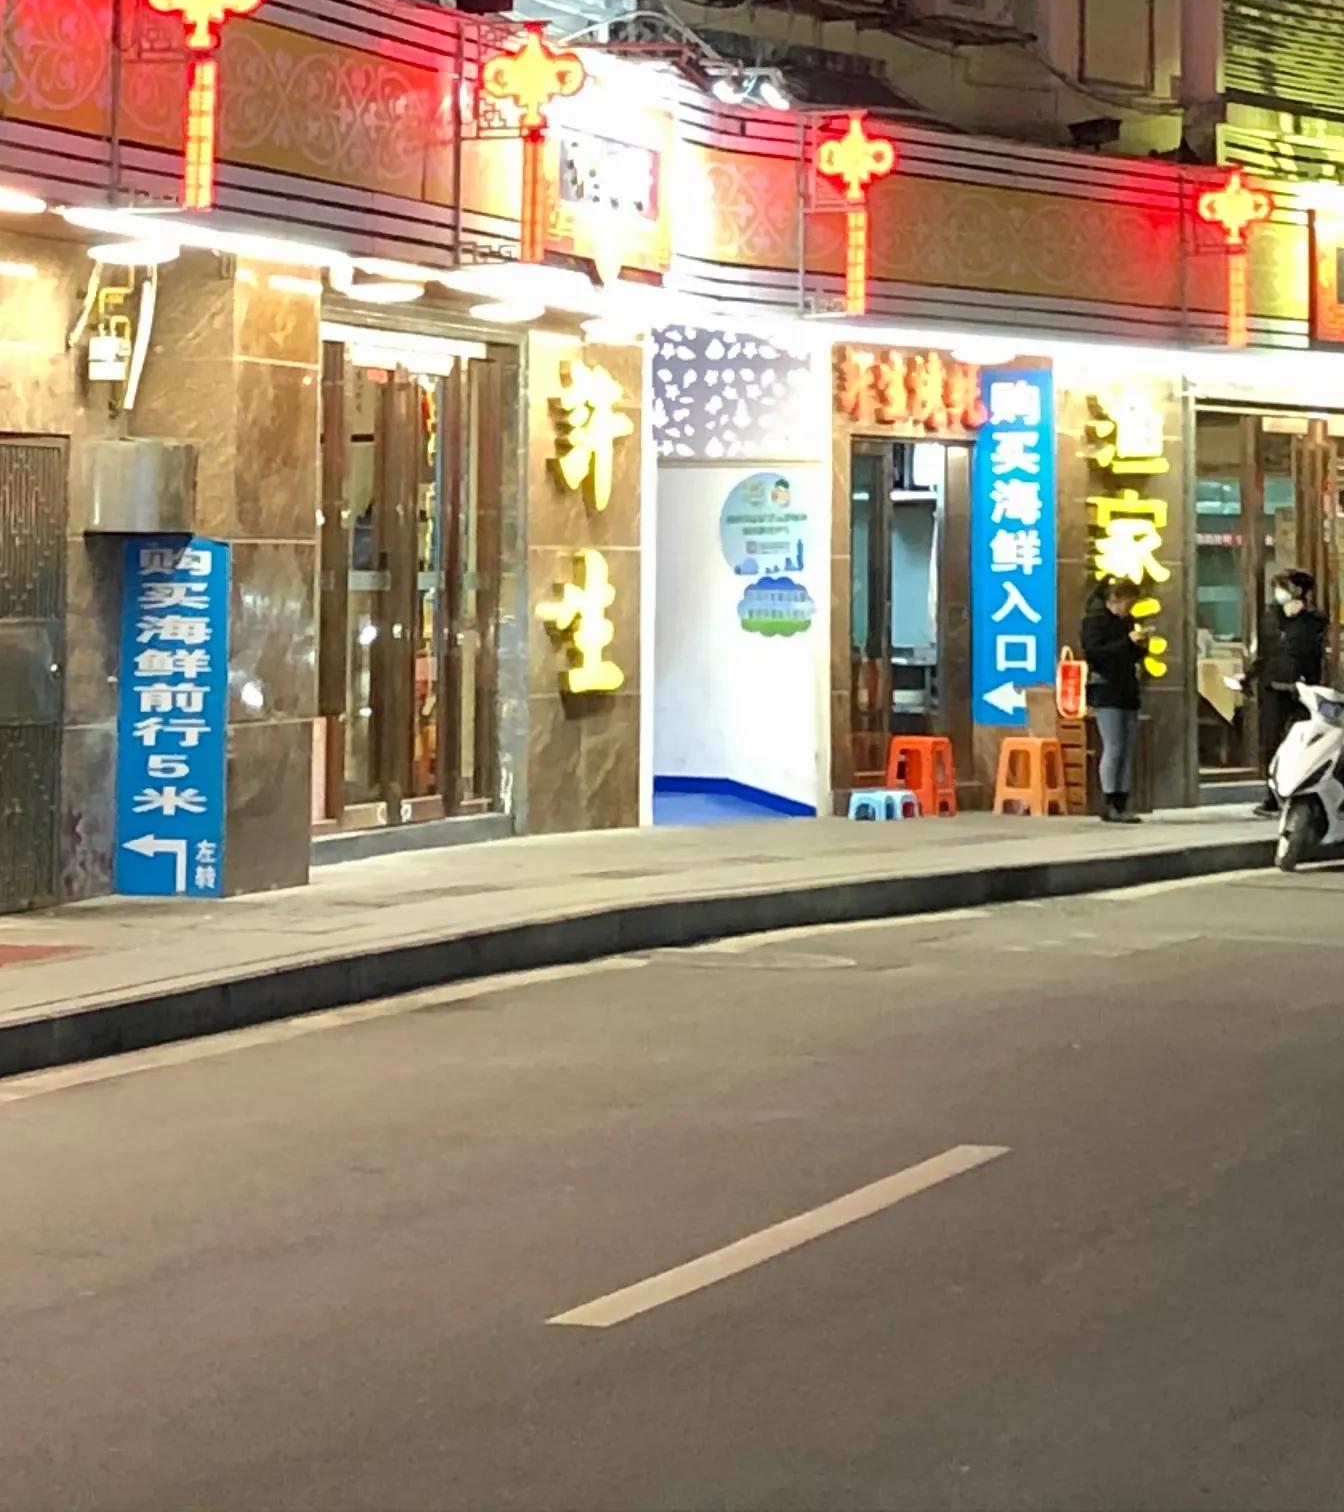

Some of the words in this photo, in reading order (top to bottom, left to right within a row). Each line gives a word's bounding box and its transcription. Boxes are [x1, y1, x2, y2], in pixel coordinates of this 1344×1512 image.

[990, 380, 1042, 673] 购买海鲜入口
[133, 547, 213, 816] 购买海鲜前行5米
[195, 839, 217, 889] 左转
